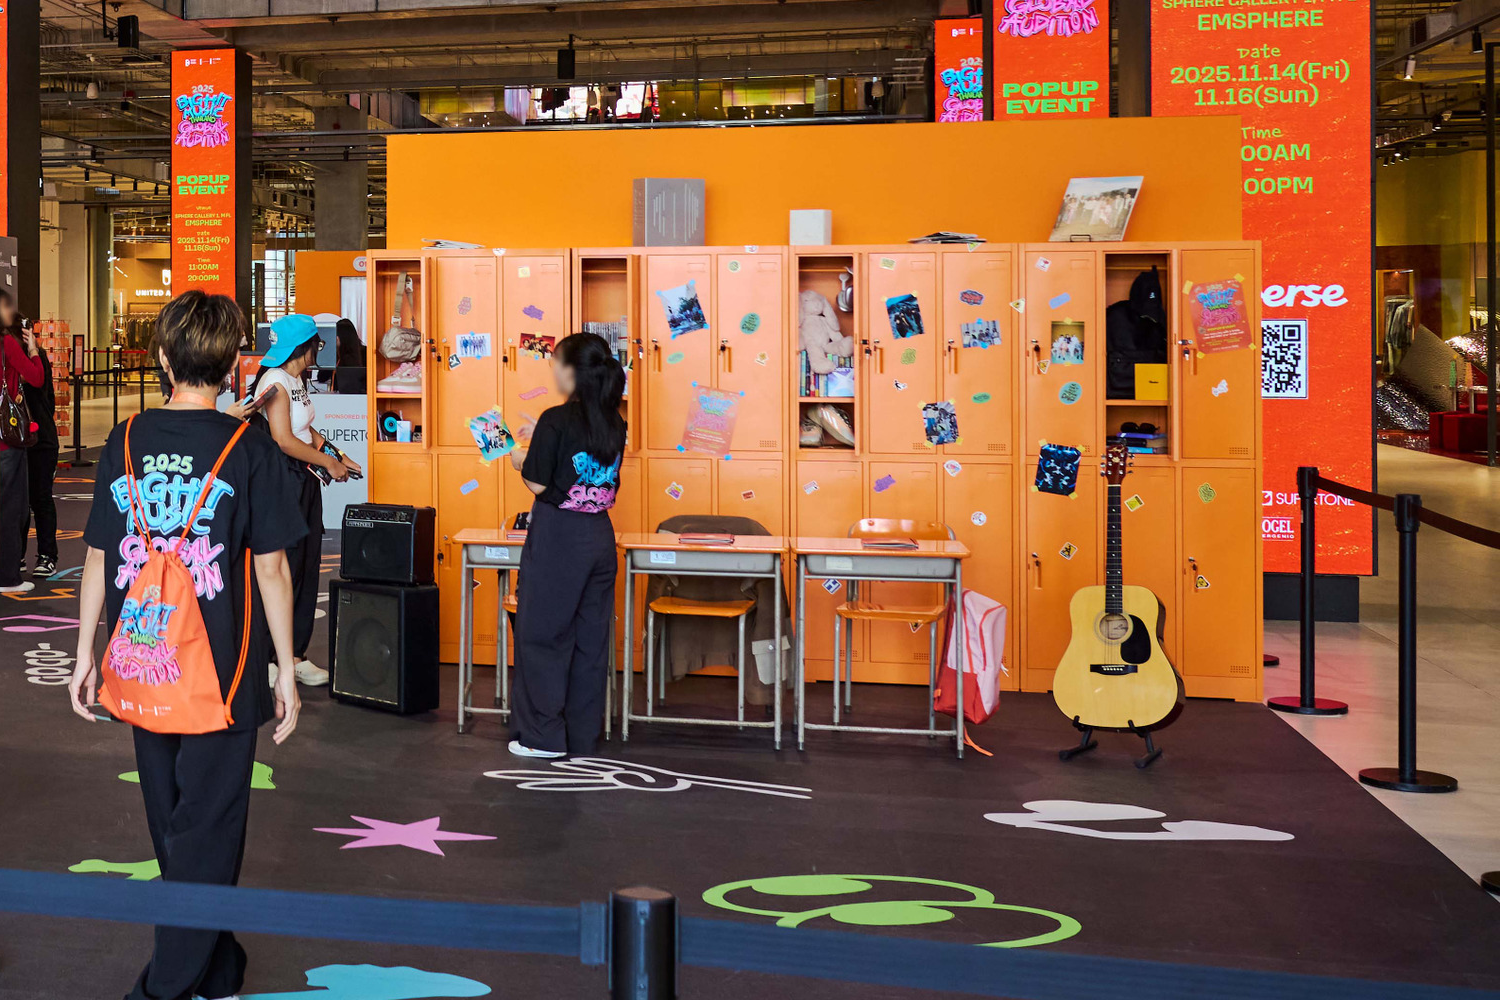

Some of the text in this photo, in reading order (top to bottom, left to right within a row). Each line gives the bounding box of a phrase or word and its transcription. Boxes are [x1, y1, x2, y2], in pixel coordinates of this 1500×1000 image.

[998, 7, 1100, 37] AUDITION
[1198, 10, 1323, 31] EMSPHERE
[1237, 44, 1281, 59] Date
[1171, 59, 1350, 84] 2025.11.14(Fri)
[191, 85, 214, 93] 2025
[1003, 81, 1098, 98] POPUP
[1194, 84, 1319, 108] 11.16(Sun)
[183, 106, 223, 121] MUSIC
[1007, 98, 1095, 114] EVENT
[178, 120, 229, 134] GLOBAL
[1242, 127, 1284, 139] Time
[174, 130, 229, 148] AUDITION
[1242, 144, 1311, 161] 00AM
[177, 175, 229, 185] POPUP
[1244, 177, 1313, 194] 00PM
[179, 185, 228, 195] EVENT
[188, 274, 219, 282] 20:00PM
[1261, 284, 1348, 307] erse
[319, 429, 368, 441] SUPERT
[142, 453, 194, 475] 2025
[126, 503, 214, 535] MUSIC
[1262, 520, 1294, 533] OGEL
